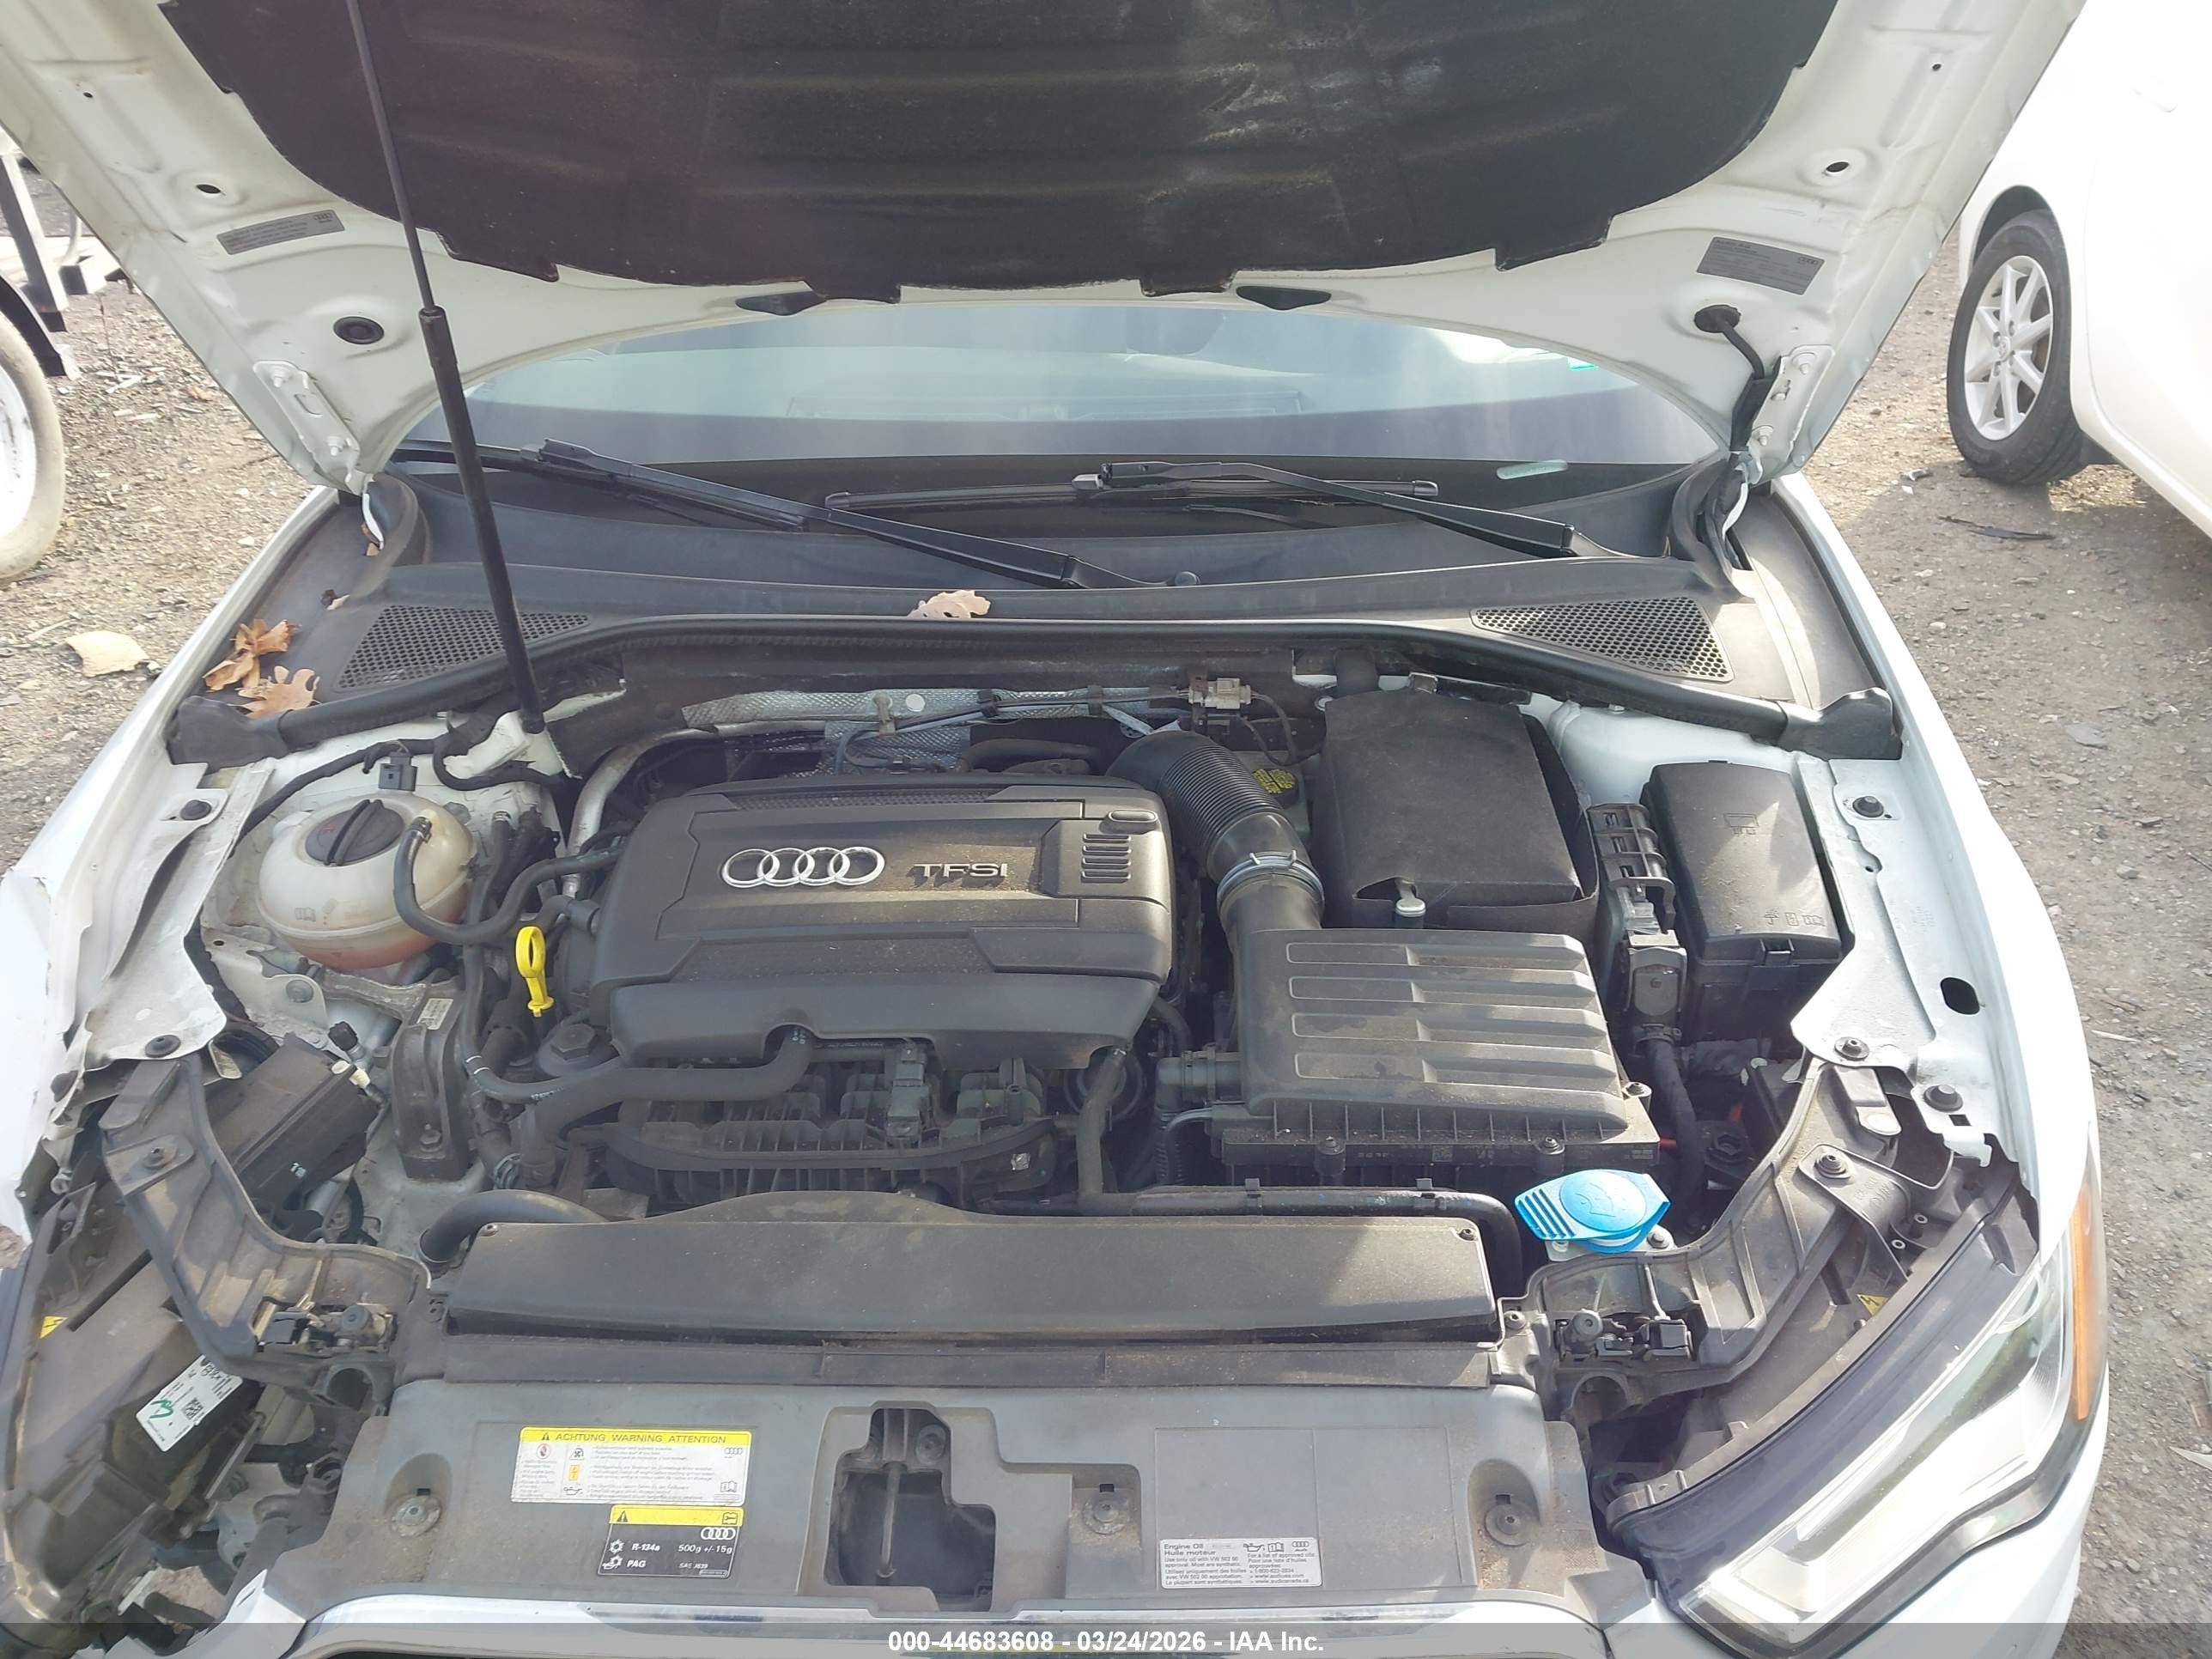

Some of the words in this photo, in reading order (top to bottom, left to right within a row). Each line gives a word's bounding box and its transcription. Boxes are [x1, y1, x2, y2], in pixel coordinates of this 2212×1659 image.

[914, 863, 1008, 877] TFSI
[556, 1433, 605, 1442] ACHTUNG
[611, 1434, 663, 1443] WARNING
[668, 1435, 726, 1443] ATTENTION
[631, 1542, 660, 1552] R-134a
[678, 1544, 702, 1553] 500g
[626, 1559, 647, 1568] PAG
